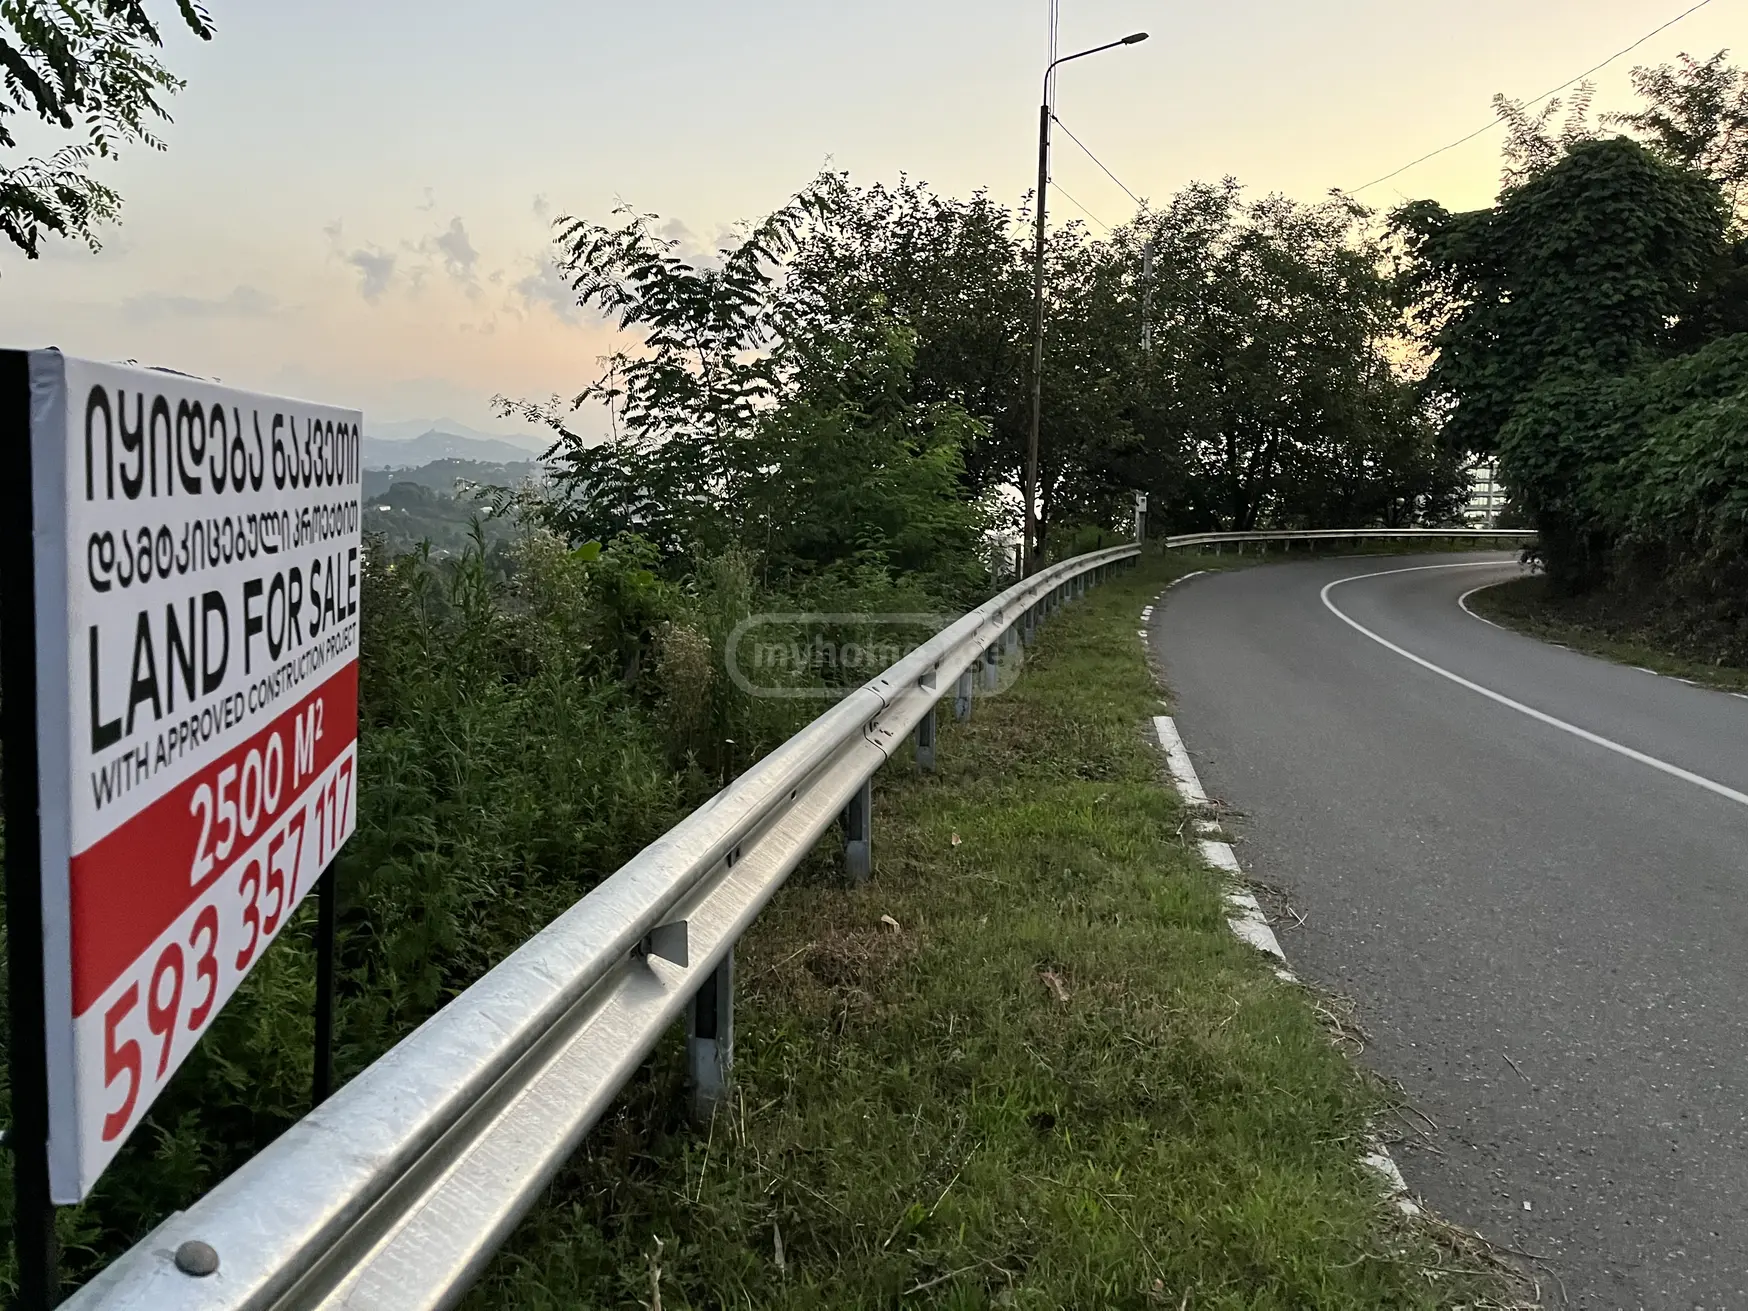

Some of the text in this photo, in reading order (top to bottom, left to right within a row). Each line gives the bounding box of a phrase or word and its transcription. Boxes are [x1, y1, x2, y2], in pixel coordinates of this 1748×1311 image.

[85, 384, 359, 500] იყიდება ნაკვეთი
[89, 547, 357, 754] LAND FOR SALE
[91, 622, 357, 811] WITH APPROVED CONSTRUCTION PROJECT
[190, 732, 284, 887] 2500
[102, 754, 353, 1142] 593 357 117
